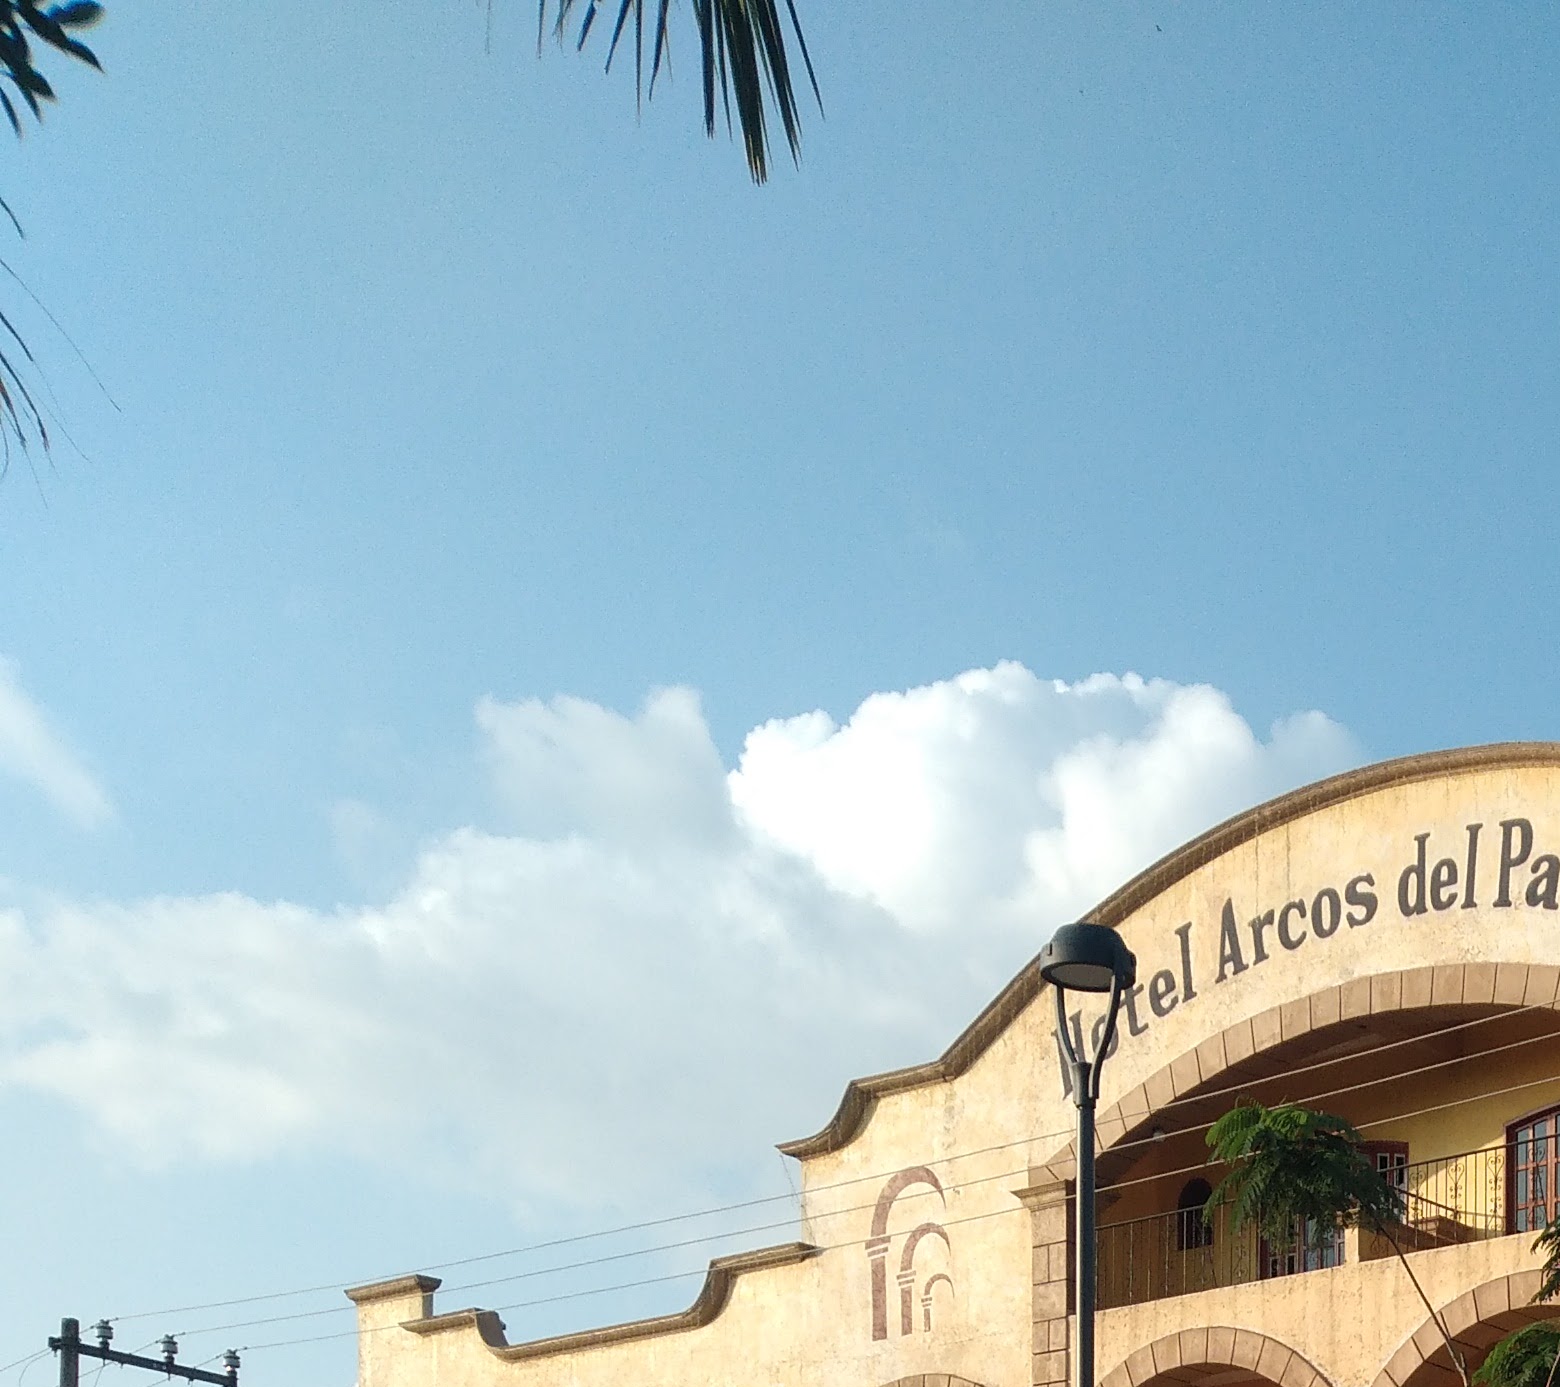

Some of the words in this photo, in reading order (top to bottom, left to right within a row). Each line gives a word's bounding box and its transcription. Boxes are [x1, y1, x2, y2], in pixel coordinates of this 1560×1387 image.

[1051, 921, 1198, 1101] Hotel
[1215, 870, 1378, 984] Arcos
[1398, 822, 1484, 918] del
